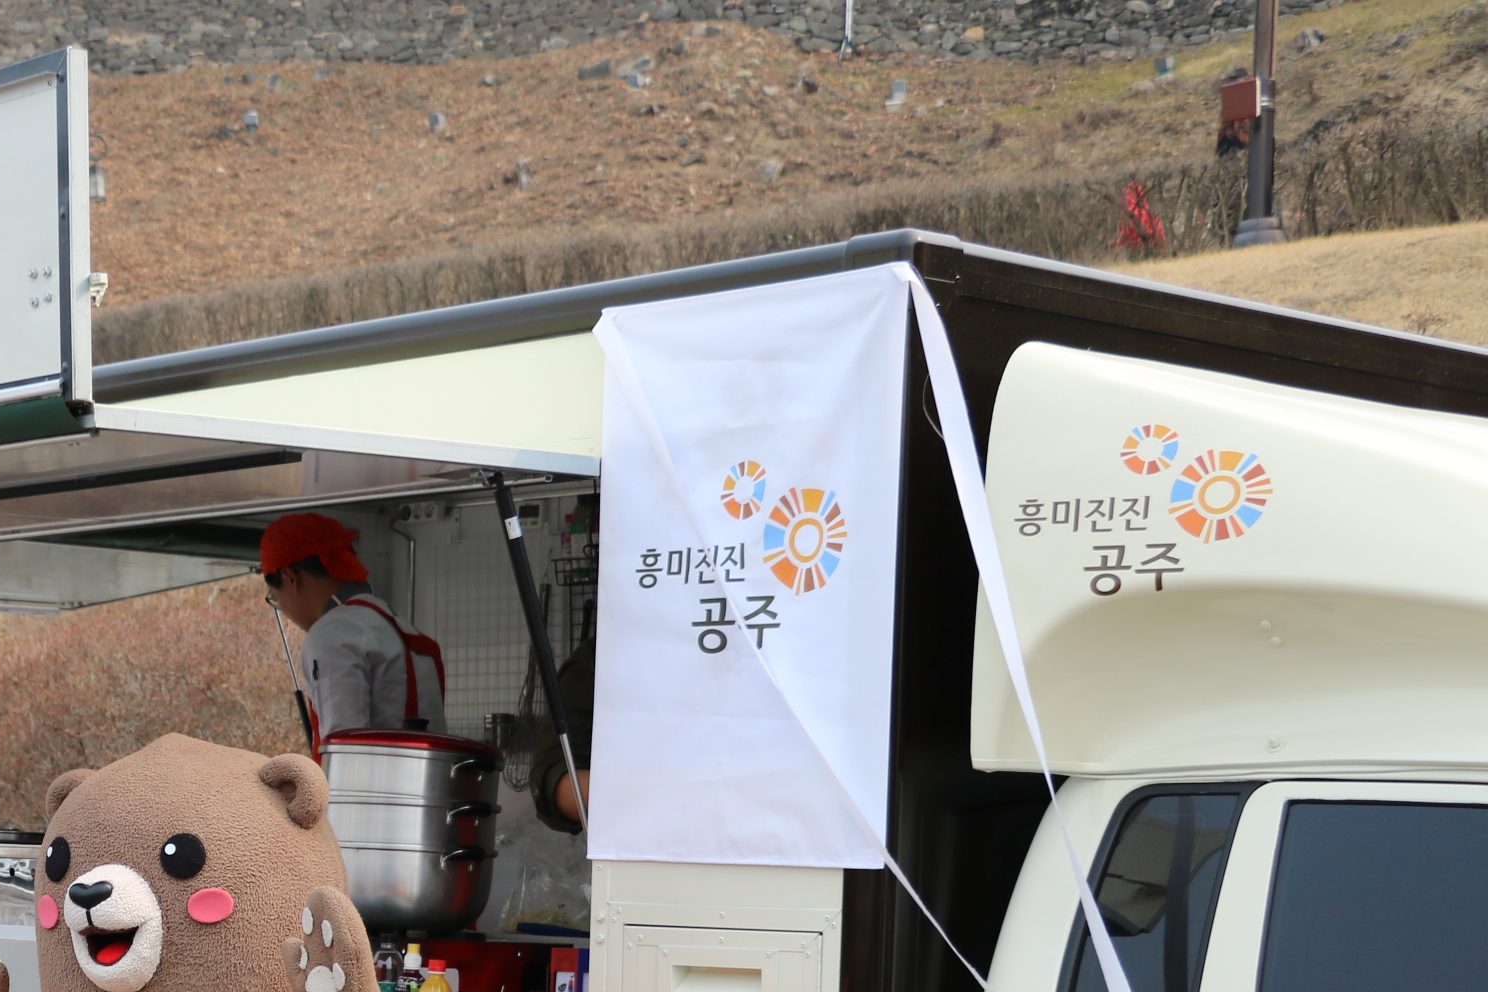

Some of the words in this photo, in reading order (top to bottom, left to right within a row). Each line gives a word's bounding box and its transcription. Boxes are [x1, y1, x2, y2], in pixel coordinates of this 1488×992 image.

[1014, 495, 1150, 537] 흥미진진
[635, 543, 745, 589] 흥미진진
[1083, 543, 1185, 597] 공주
[691, 595, 781, 654] 공주
